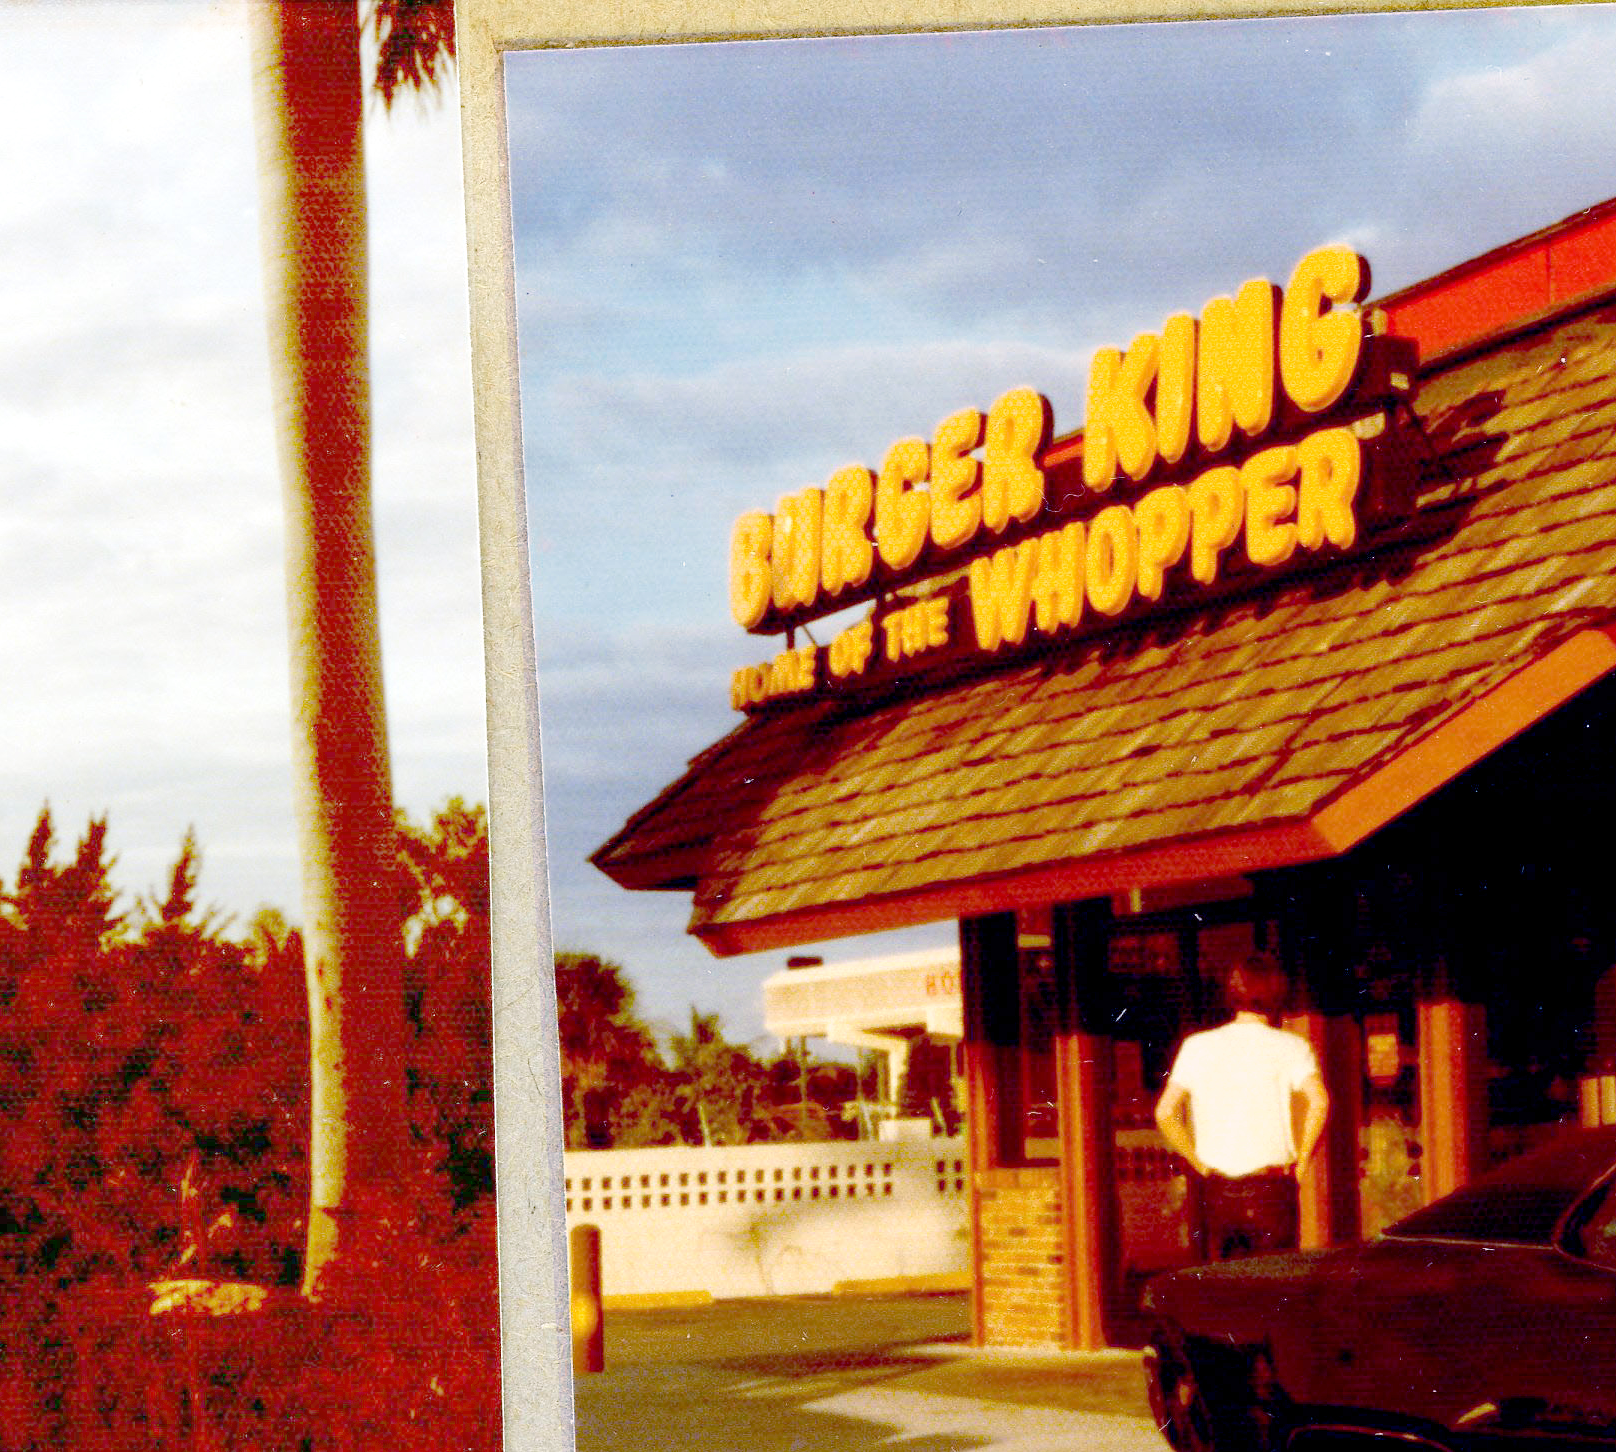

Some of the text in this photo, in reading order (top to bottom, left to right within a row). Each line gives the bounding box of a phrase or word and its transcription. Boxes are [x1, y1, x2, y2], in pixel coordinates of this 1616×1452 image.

[730, 244, 1367, 628] BURGER KING
[730, 427, 1361, 710] HOME OF THE WHOPPER
